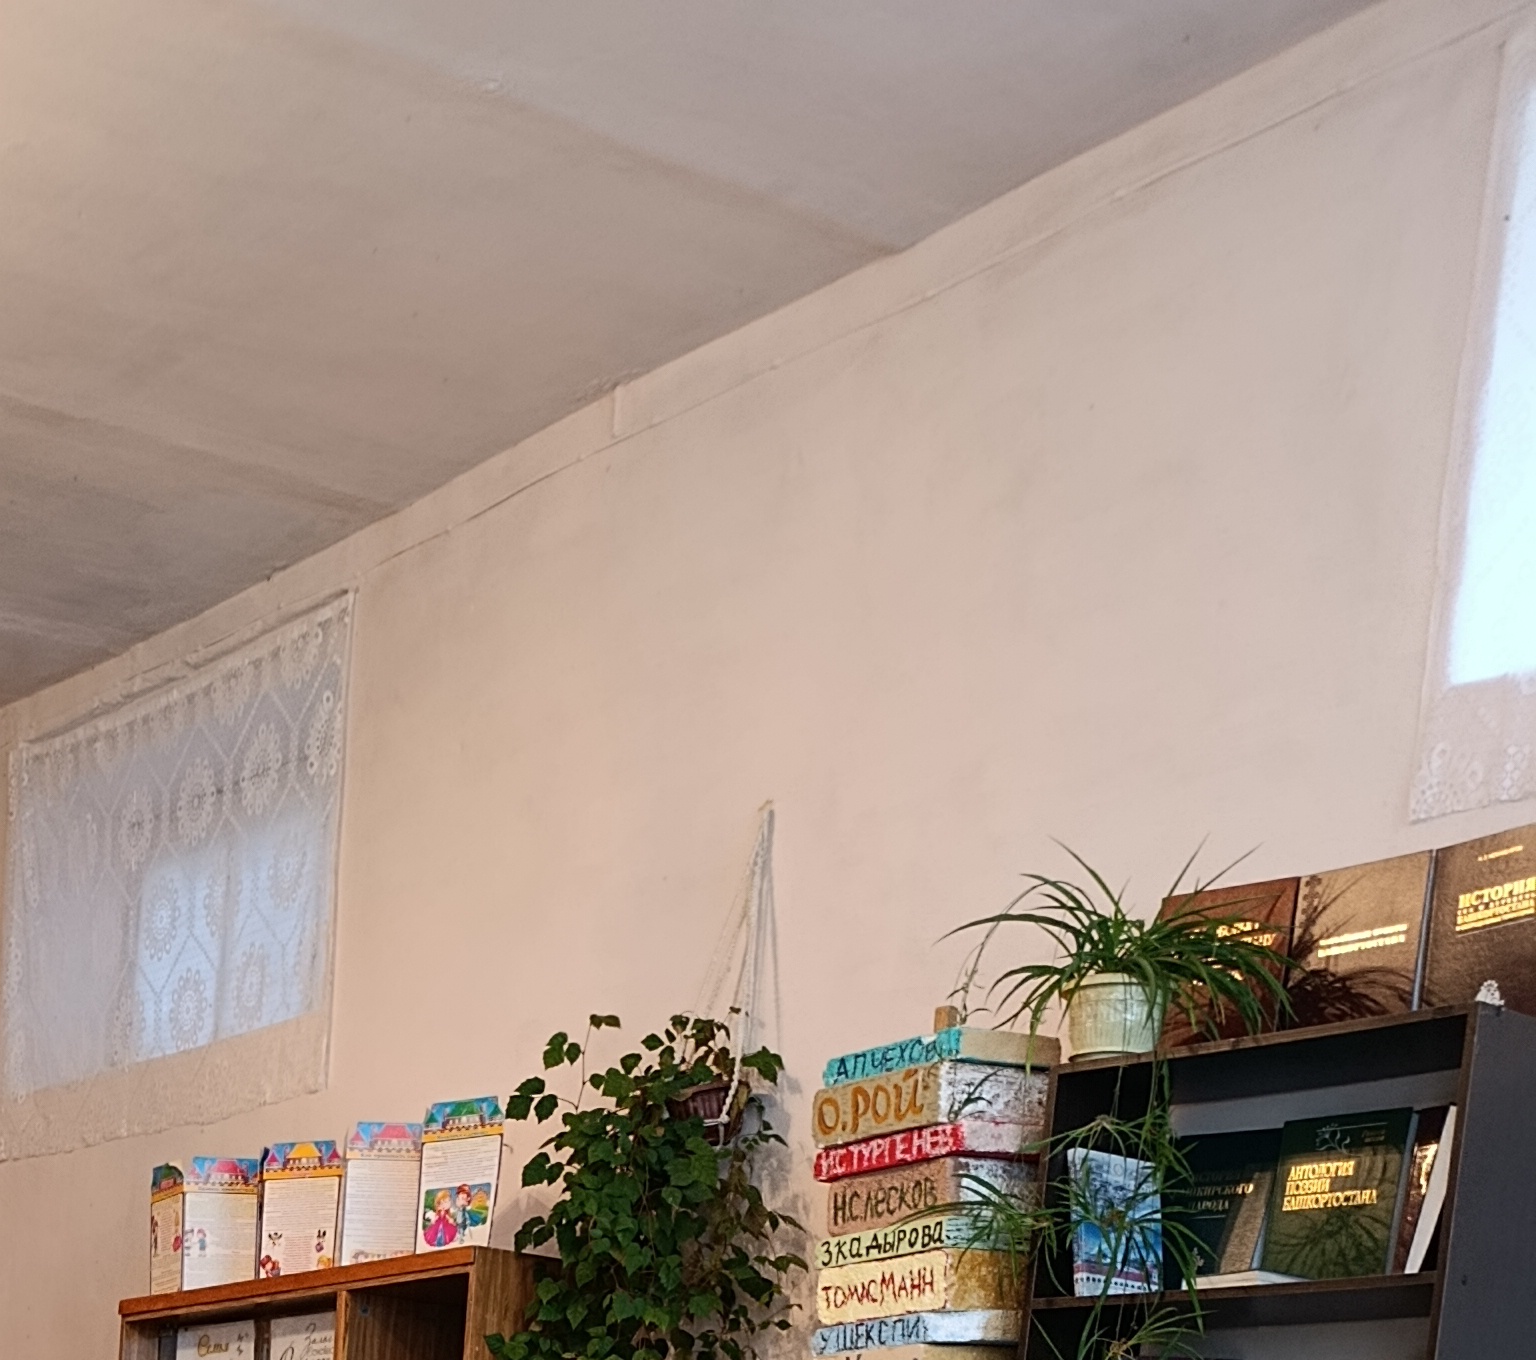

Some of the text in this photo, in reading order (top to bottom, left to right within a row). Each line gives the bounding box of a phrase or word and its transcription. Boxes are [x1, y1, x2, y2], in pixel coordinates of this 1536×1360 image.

[1288, 1161, 1355, 1180] АНТОЛОГИЯ
[1285, 1179, 1331, 1196] ПОЭЗИИ
[1282, 1189, 1378, 1211] БАШКОРТОСТАНА
